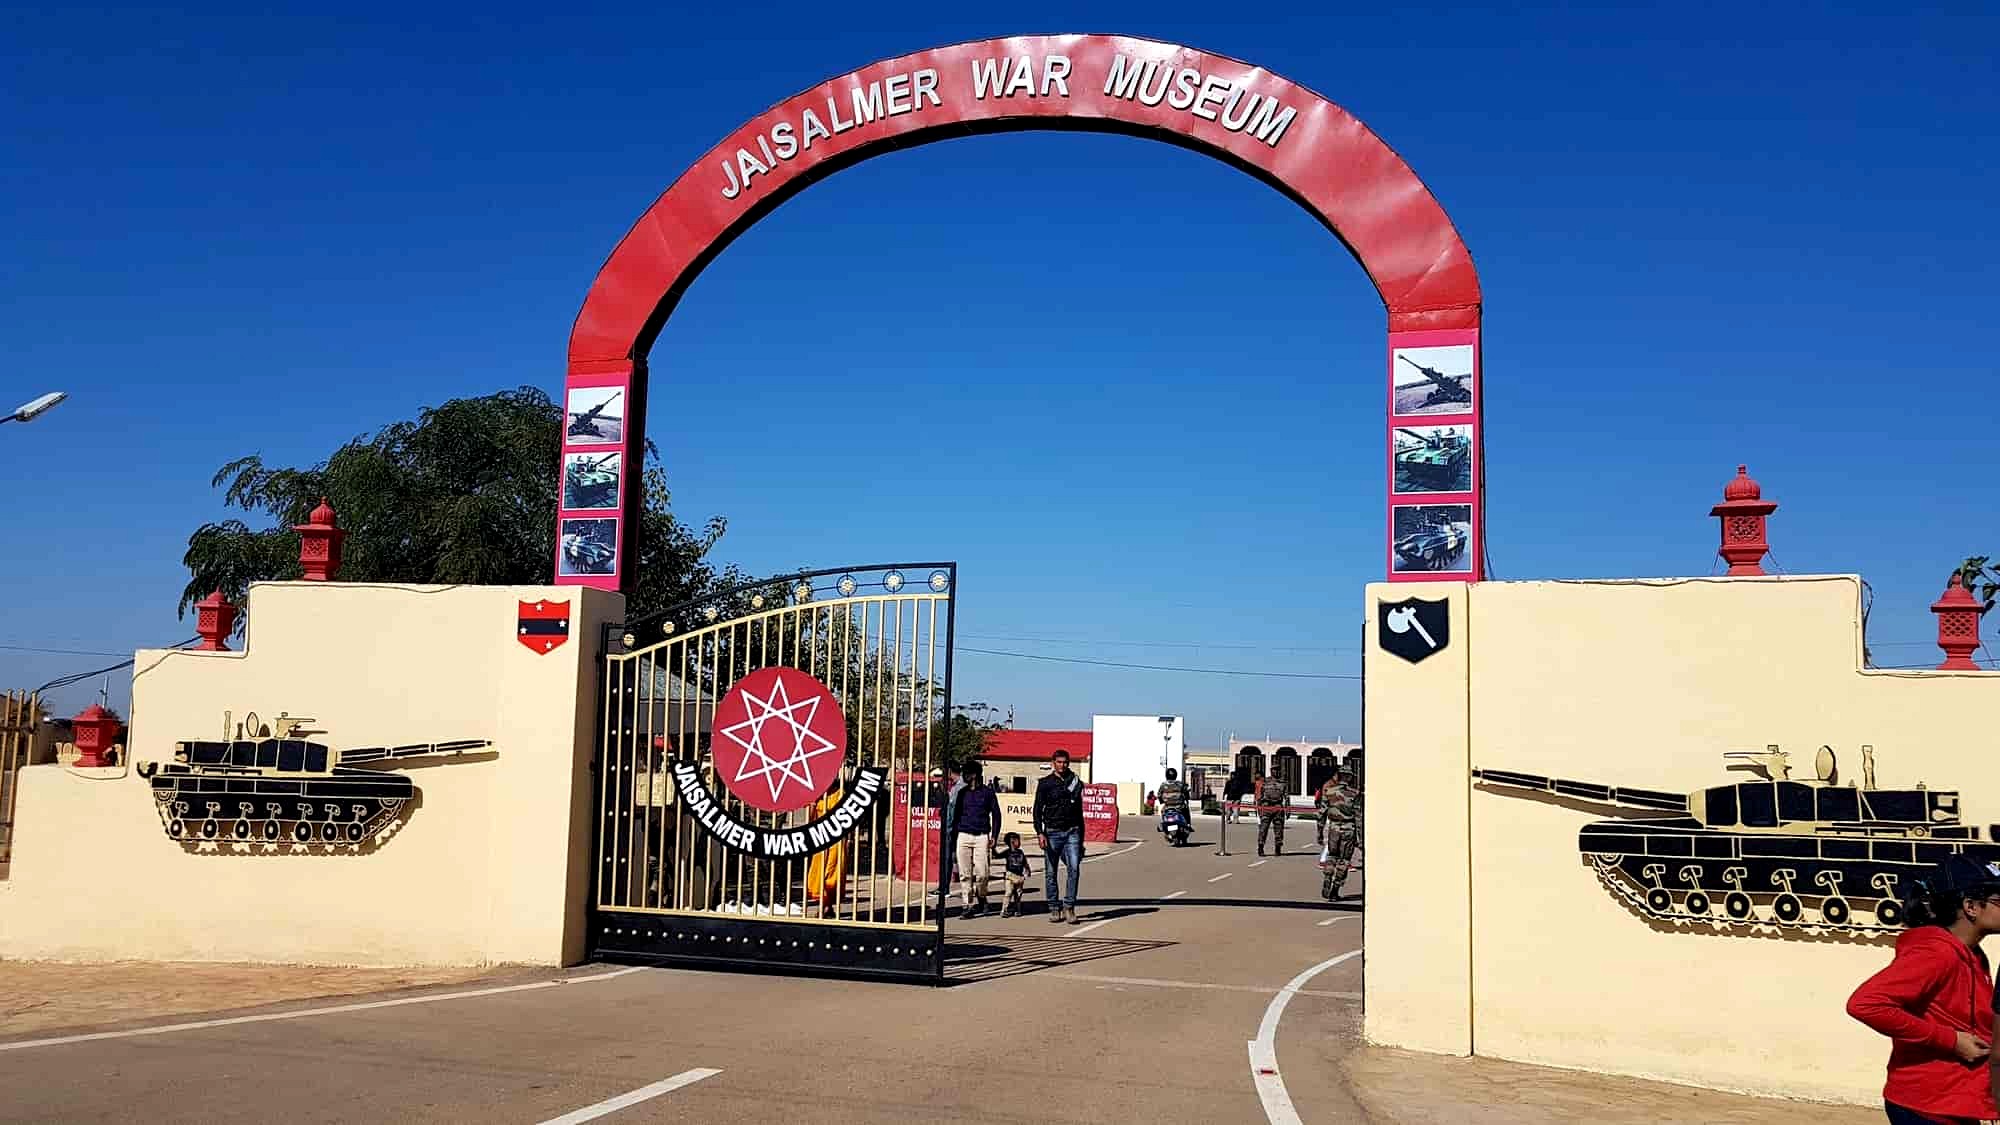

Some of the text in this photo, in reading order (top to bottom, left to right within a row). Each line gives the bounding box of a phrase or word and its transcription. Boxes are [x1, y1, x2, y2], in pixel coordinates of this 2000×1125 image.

[721, 54, 1297, 199] JAISALMER WAR MUSEUM
[674, 762, 882, 857] JAISALMER WAR MUSEUM
